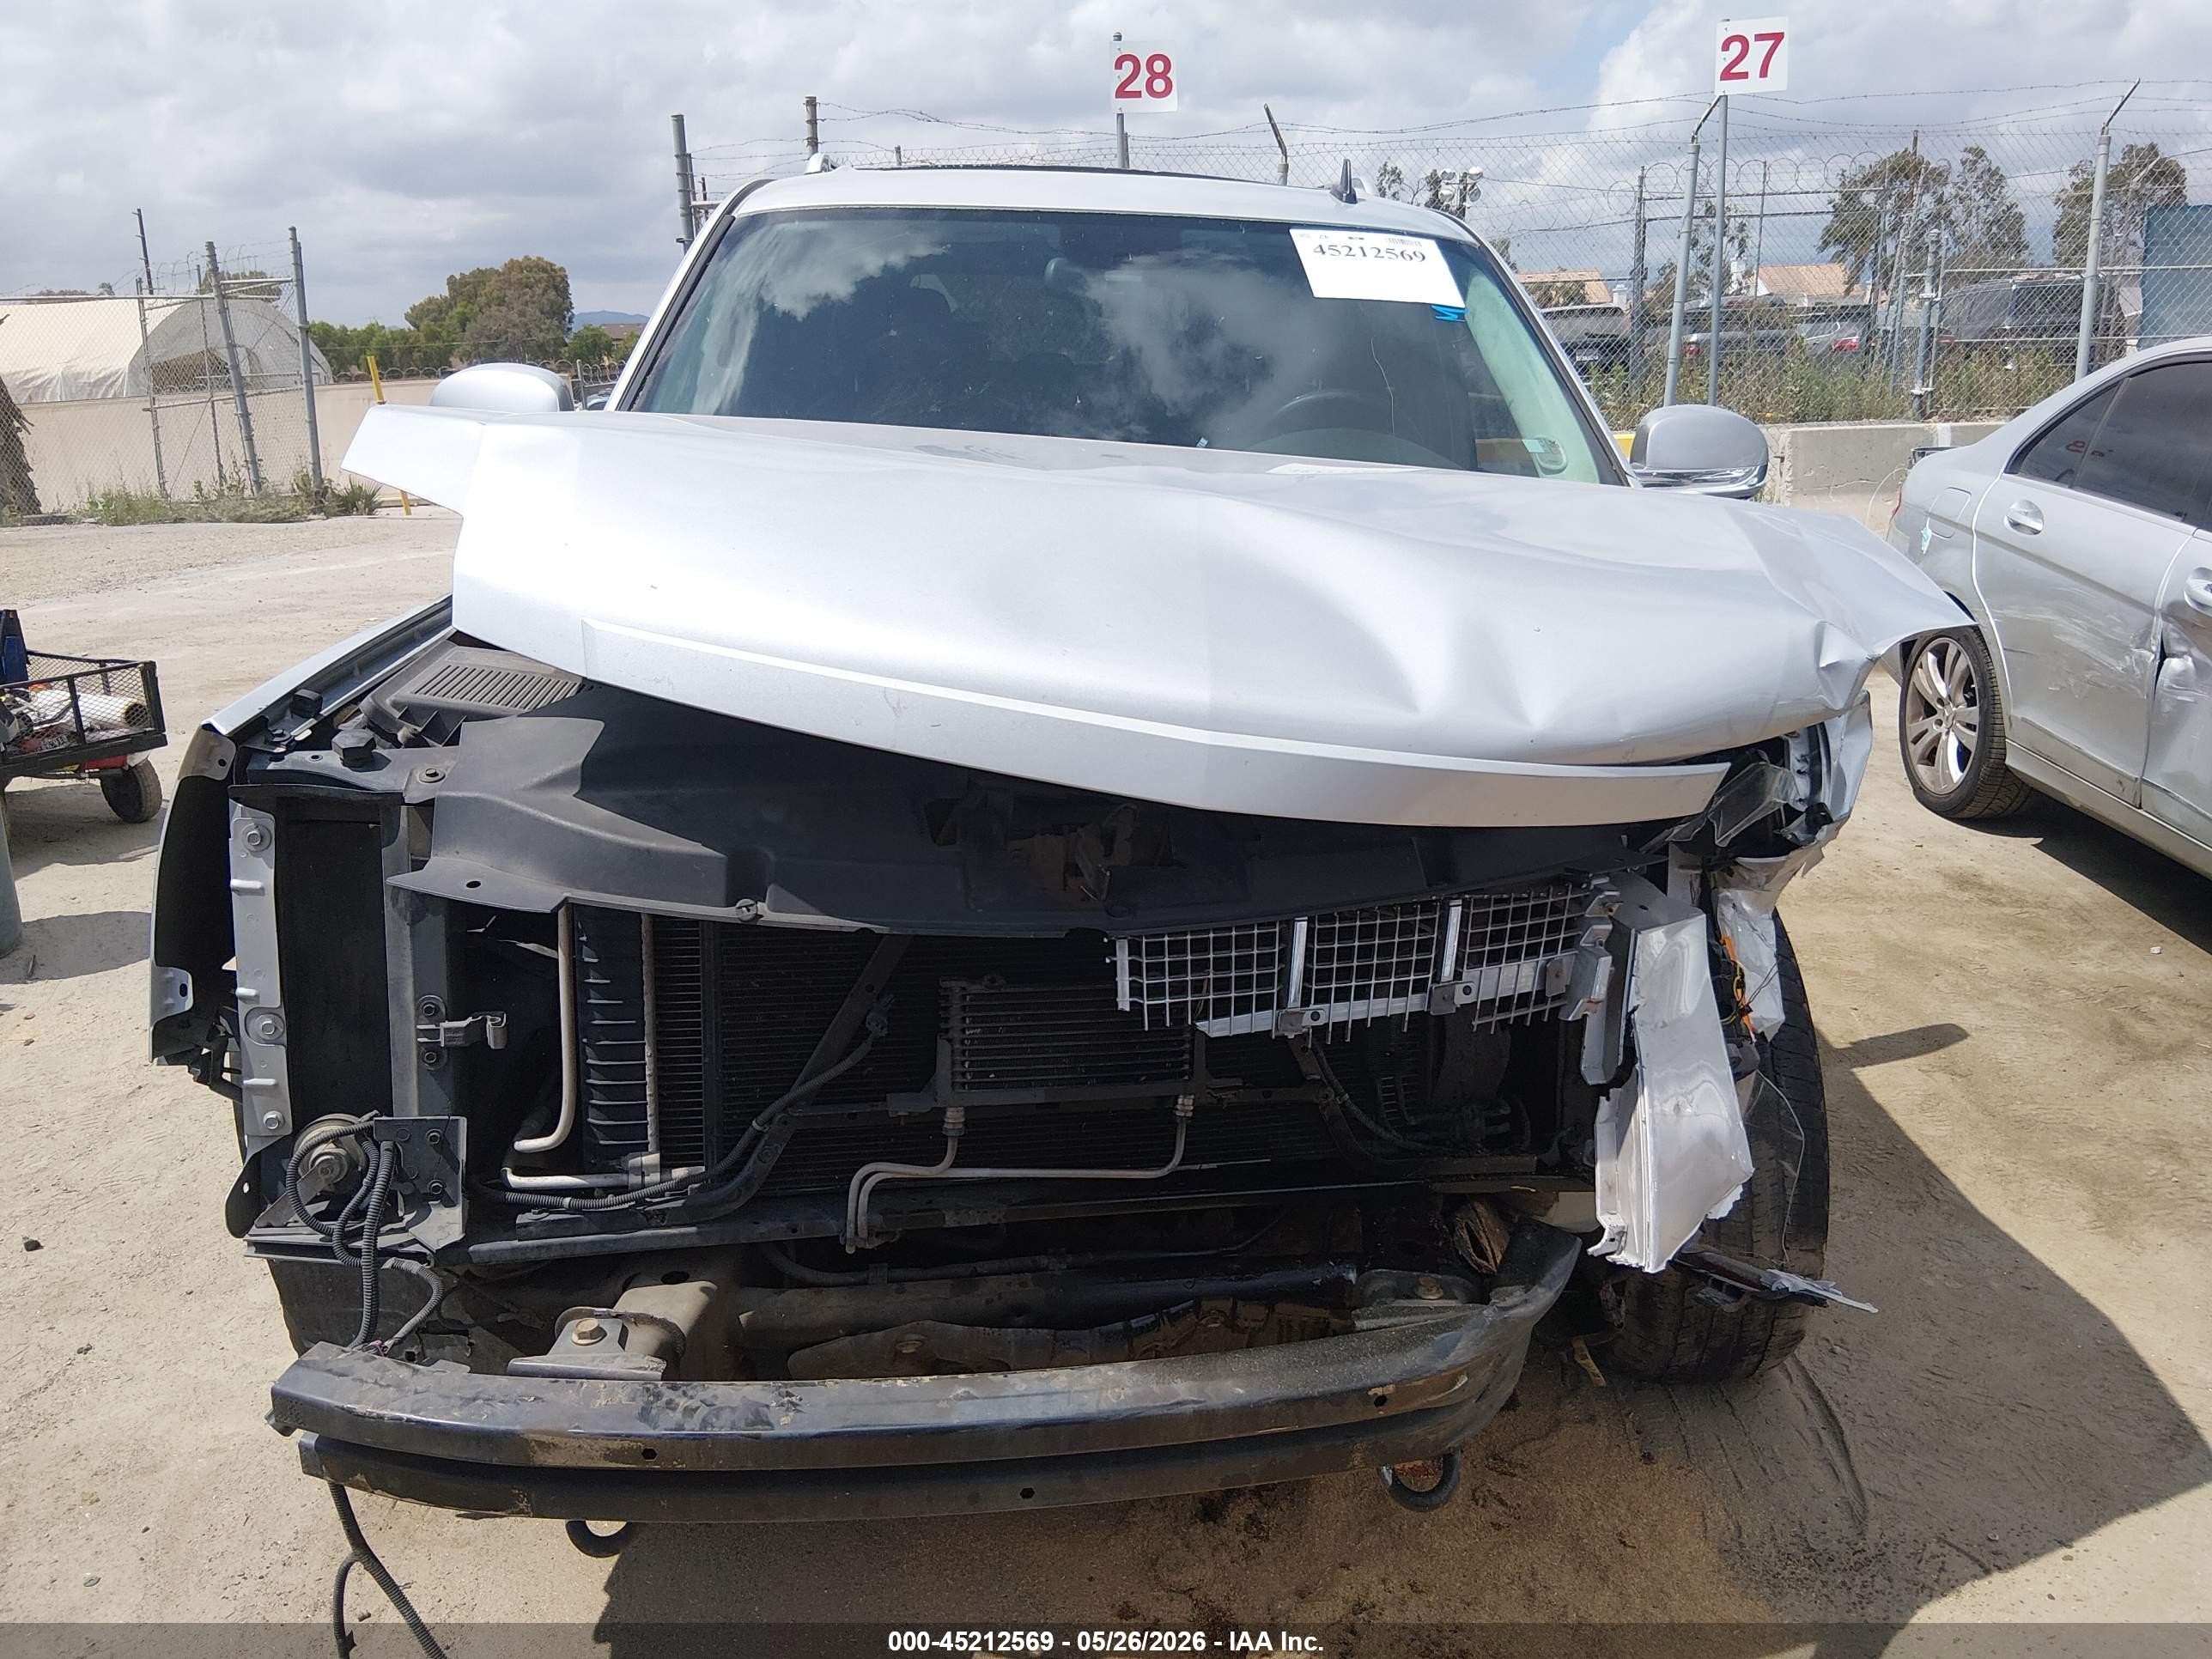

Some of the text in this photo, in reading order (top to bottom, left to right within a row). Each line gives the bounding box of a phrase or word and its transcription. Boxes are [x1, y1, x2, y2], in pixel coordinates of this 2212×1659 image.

[1114, 53, 1173, 99] 28
[1719, 32, 1785, 82] 27
[1313, 243, 1426, 263] 45212569
